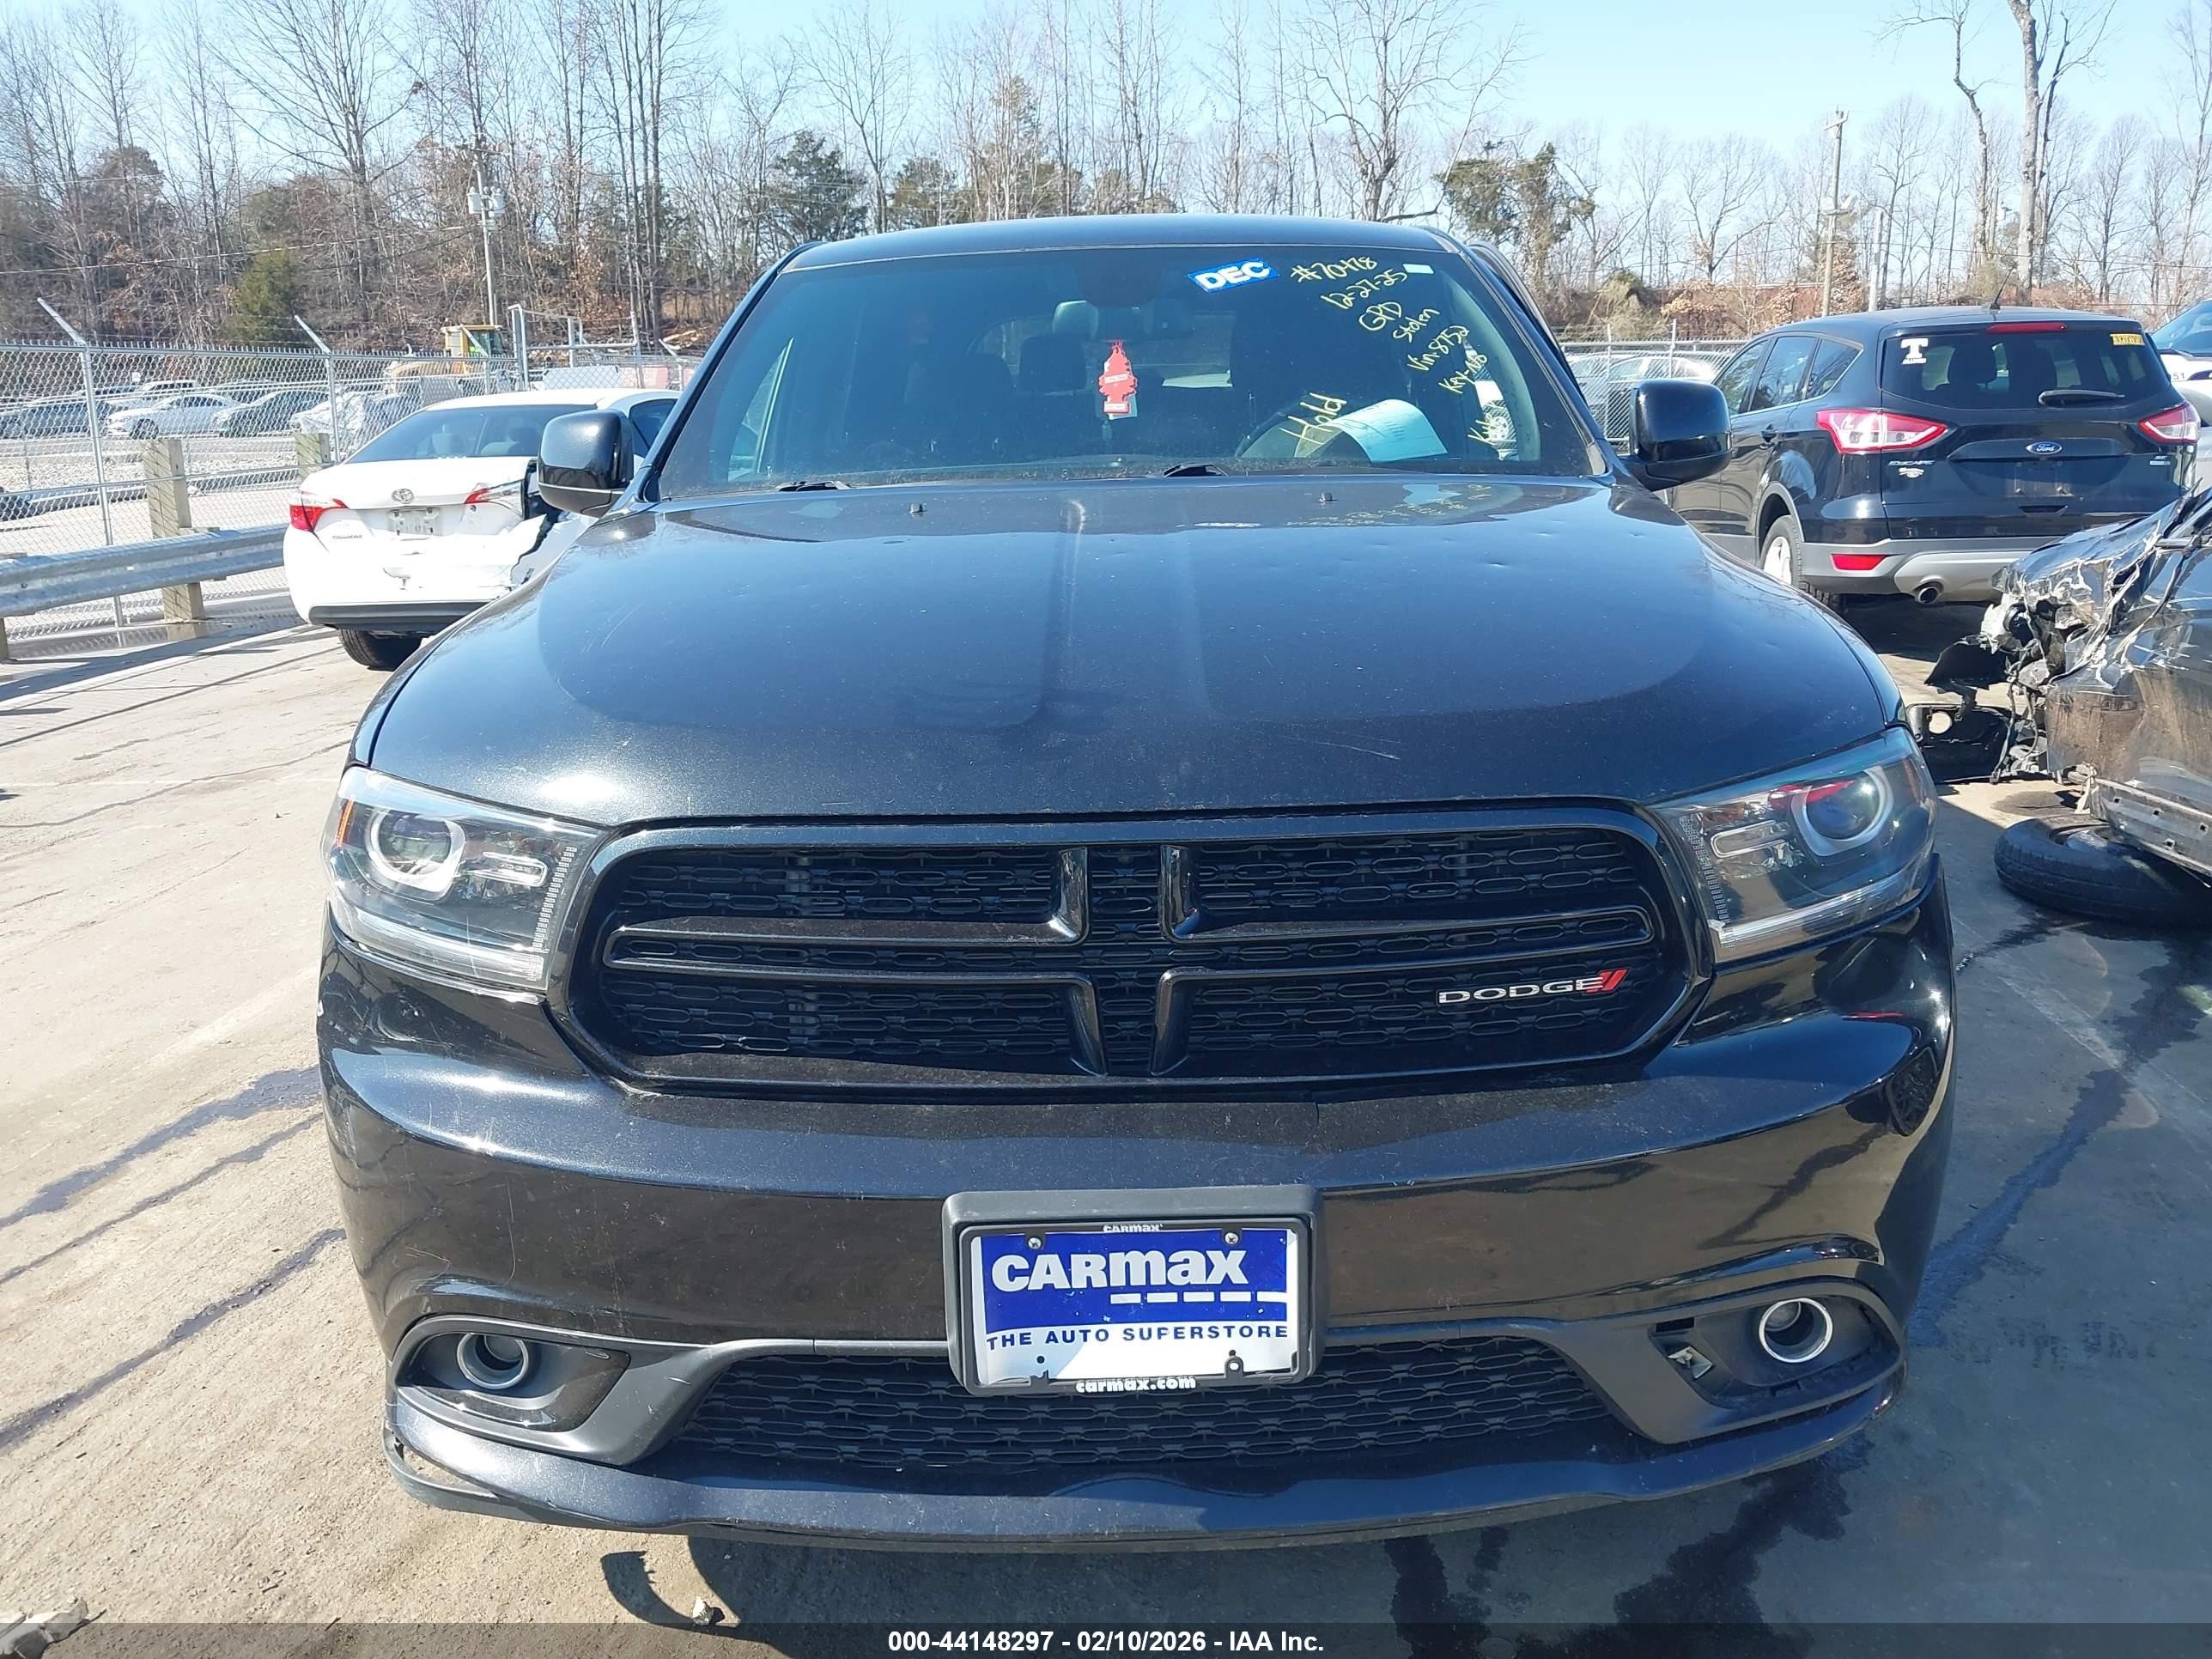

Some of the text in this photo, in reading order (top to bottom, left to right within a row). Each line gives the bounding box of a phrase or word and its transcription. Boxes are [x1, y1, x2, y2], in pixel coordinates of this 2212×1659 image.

[1203, 260, 1272, 290] DEC
[1290, 256, 1377, 282] #70478
[1320, 268, 1408, 309] 12-27-25
[1358, 301, 1402, 331] GPD
[1279, 392, 1347, 445] Hold
[1438, 976, 1604, 1004] DODGE
[987, 1324, 1289, 1351] THE AUTO SUPERSTORE
[1075, 1376, 1197, 1394] carmax.com
